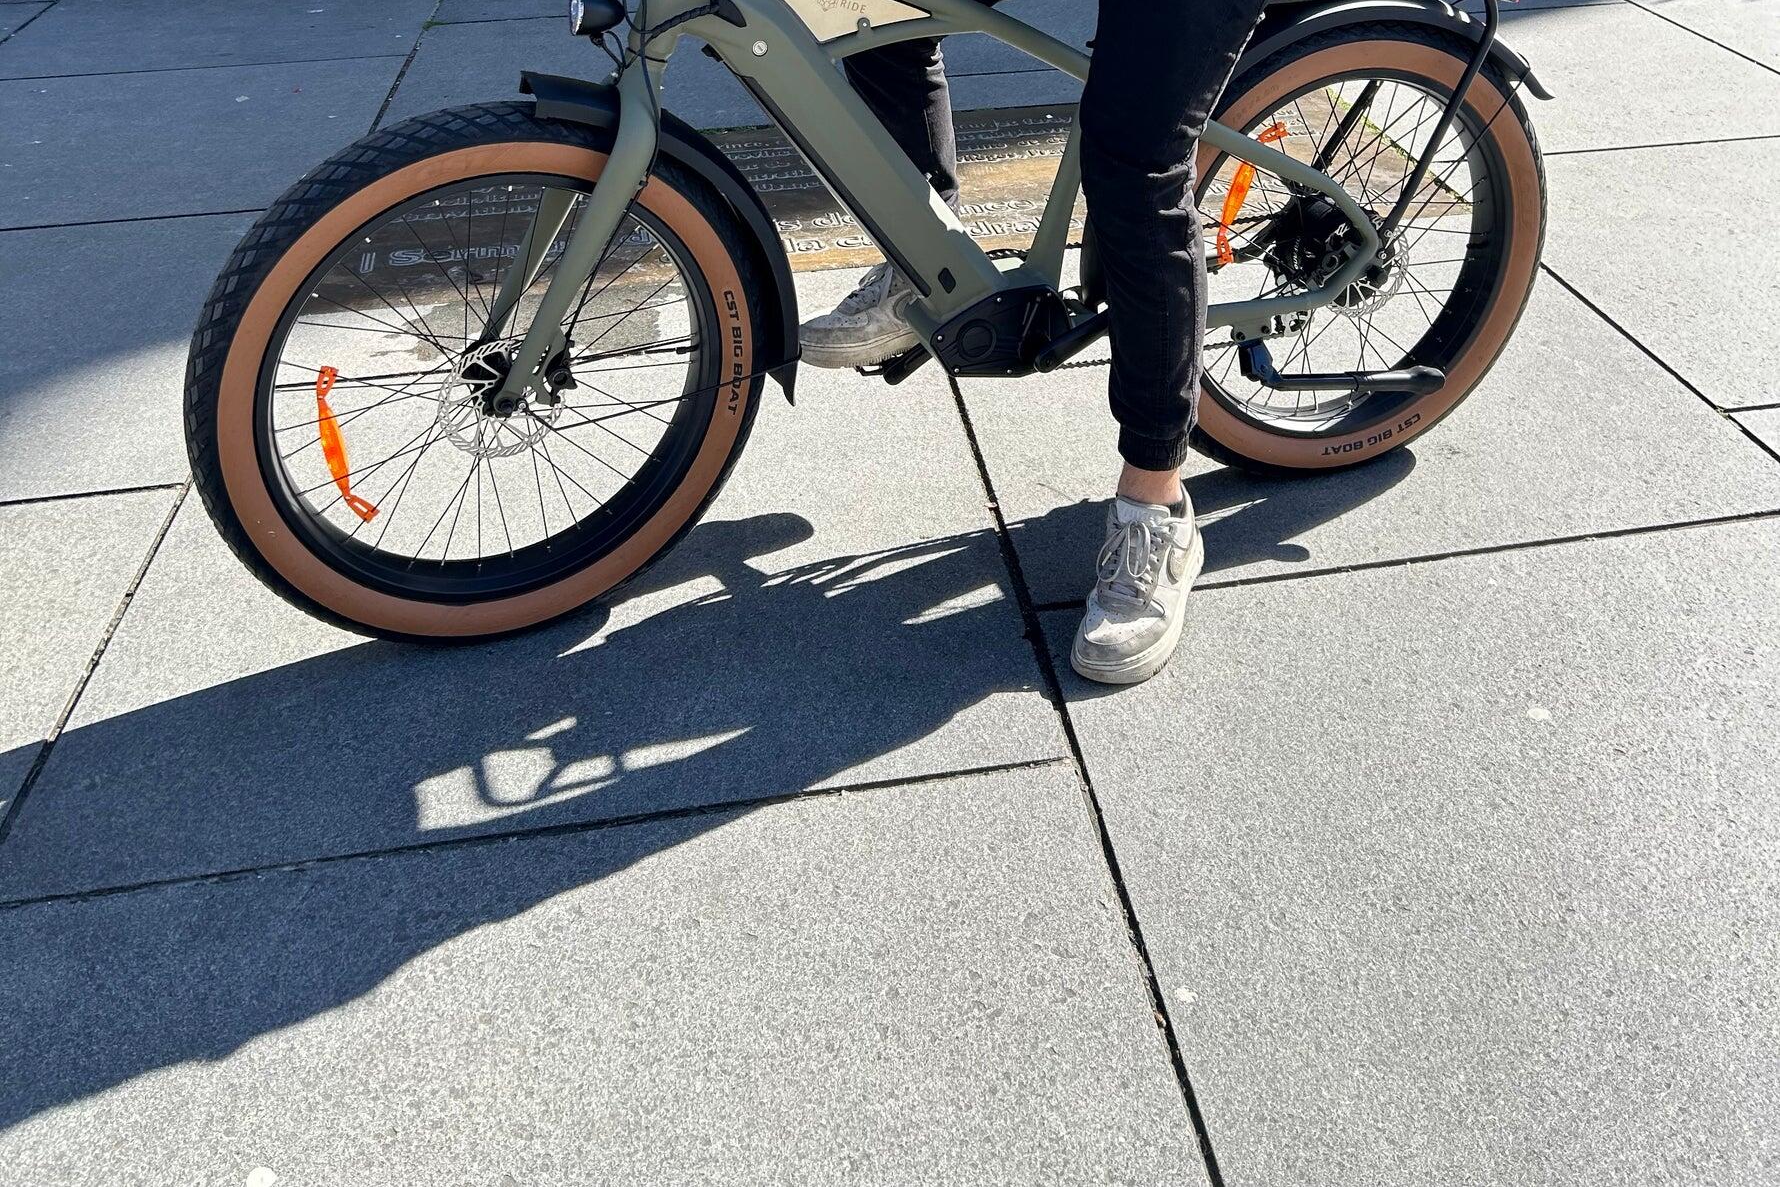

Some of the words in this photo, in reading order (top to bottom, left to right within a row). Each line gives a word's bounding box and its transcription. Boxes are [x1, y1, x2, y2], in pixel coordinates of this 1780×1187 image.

[840, 0, 868, 14] RIDE
[723, 290, 740, 321] CST
[731, 326, 743, 358] BIG
[728, 362, 743, 416] BOAT
[1396, 412, 1421, 434] CST
[1321, 440, 1363, 456] BOAT
[1367, 428, 1393, 446] BIG
